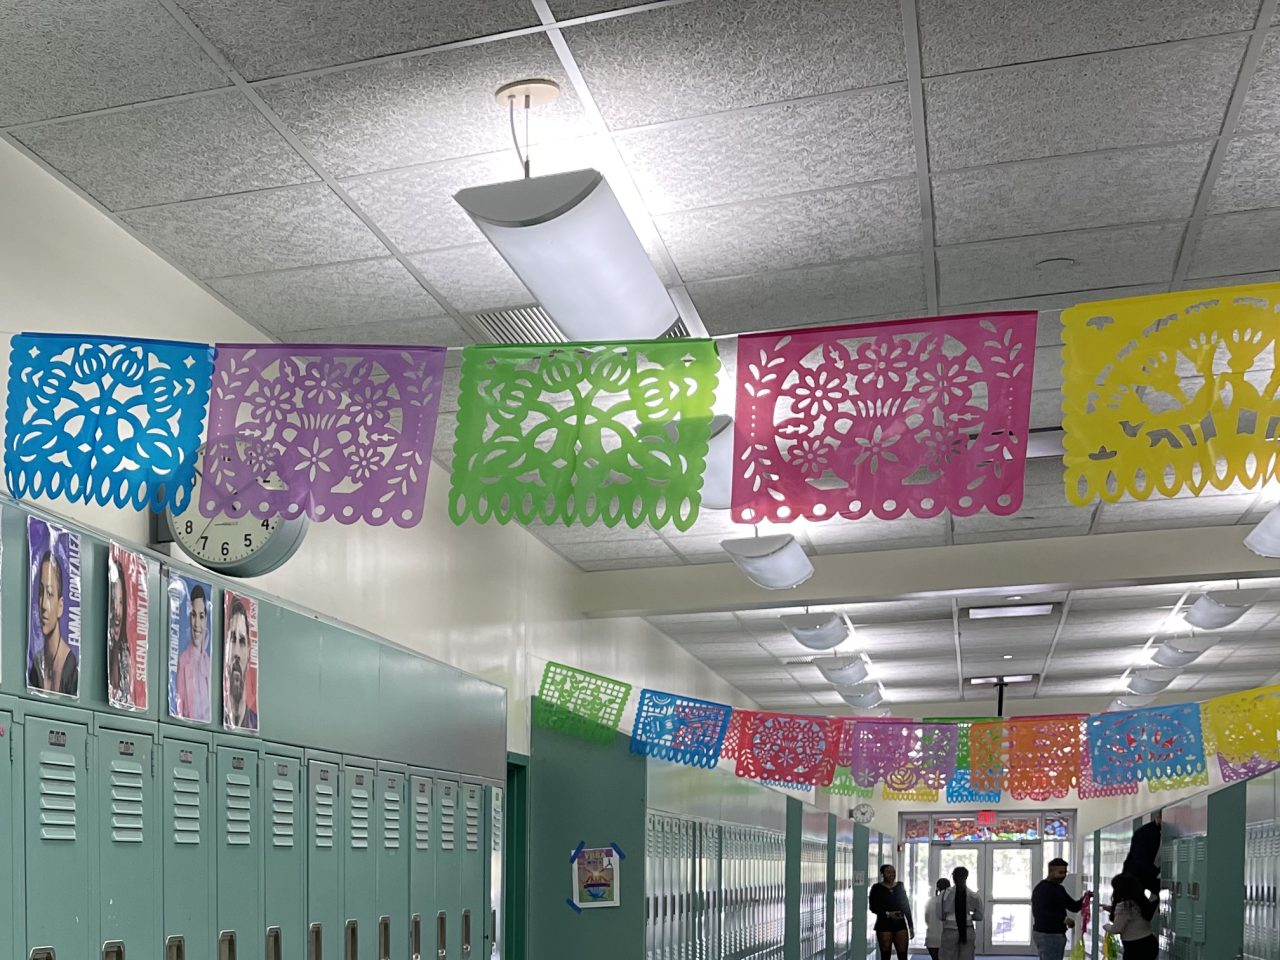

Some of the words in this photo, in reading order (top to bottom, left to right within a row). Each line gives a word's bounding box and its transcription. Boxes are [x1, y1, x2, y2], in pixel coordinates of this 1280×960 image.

[185, 520, 193, 534] 8
[261, 519, 269, 531] 4
[200, 536, 209, 550] 7
[244, 533, 252, 547] 5
[221, 542, 229, 556] 6
[68, 533, 80, 602] GONZALEZ
[68, 606, 80, 646] EMMA
[136, 639, 147, 682] SELENA
